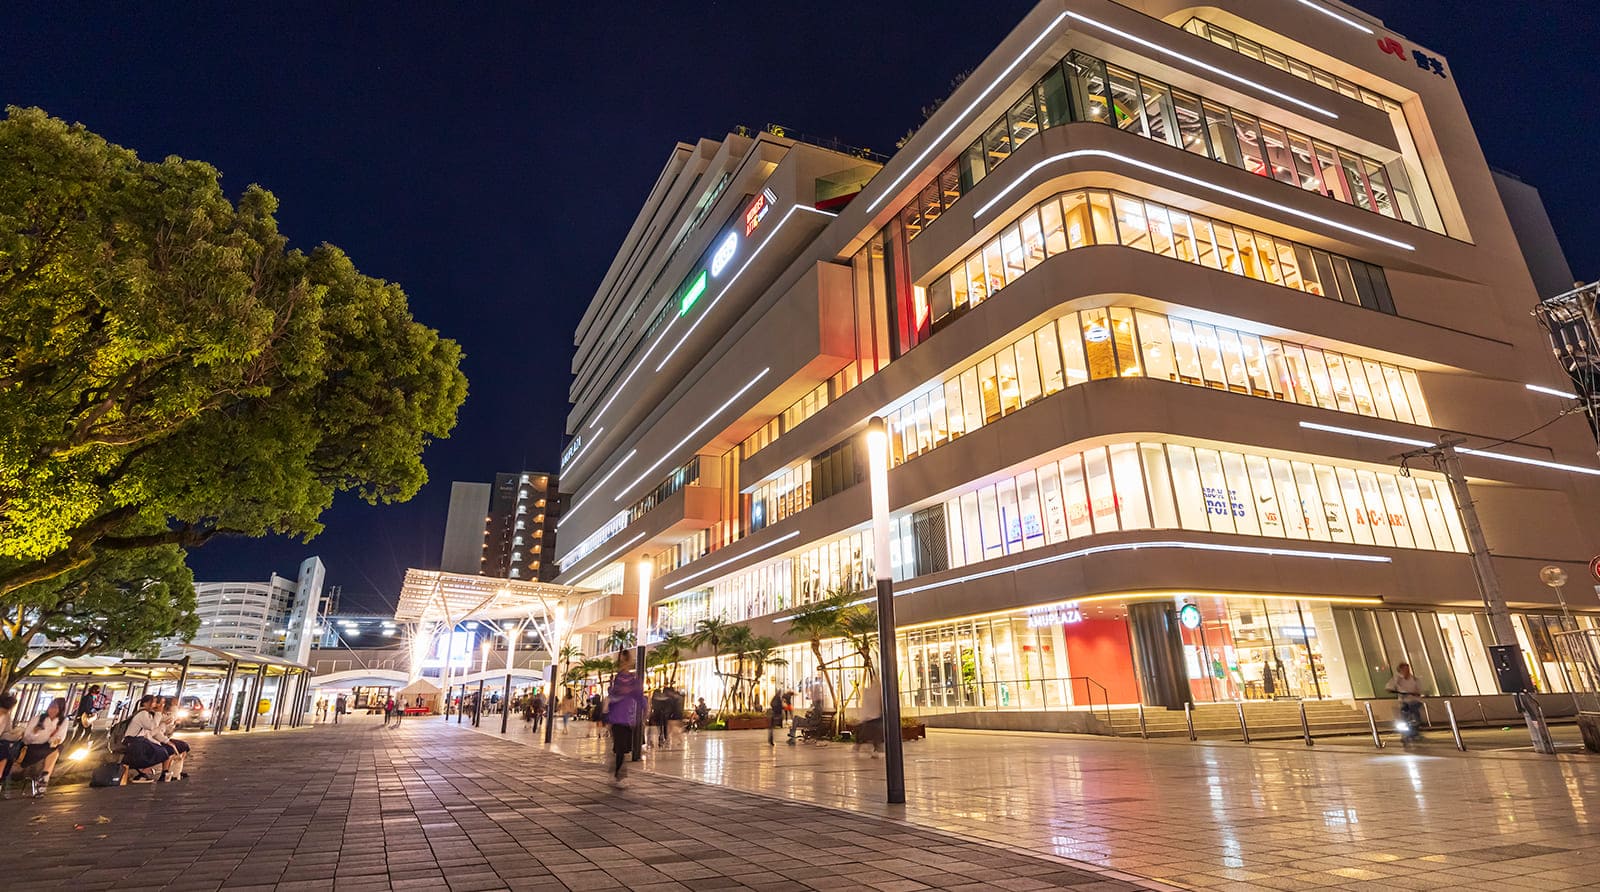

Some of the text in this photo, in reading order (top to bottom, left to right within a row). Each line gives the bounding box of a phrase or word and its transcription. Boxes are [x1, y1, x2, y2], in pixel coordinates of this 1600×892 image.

[1377, 36, 1407, 61] JR
[1202, 499, 1245, 517] POTS
[1355, 507, 1406, 527] AC-ART
[1028, 609, 1082, 627] AMUPLAZA
